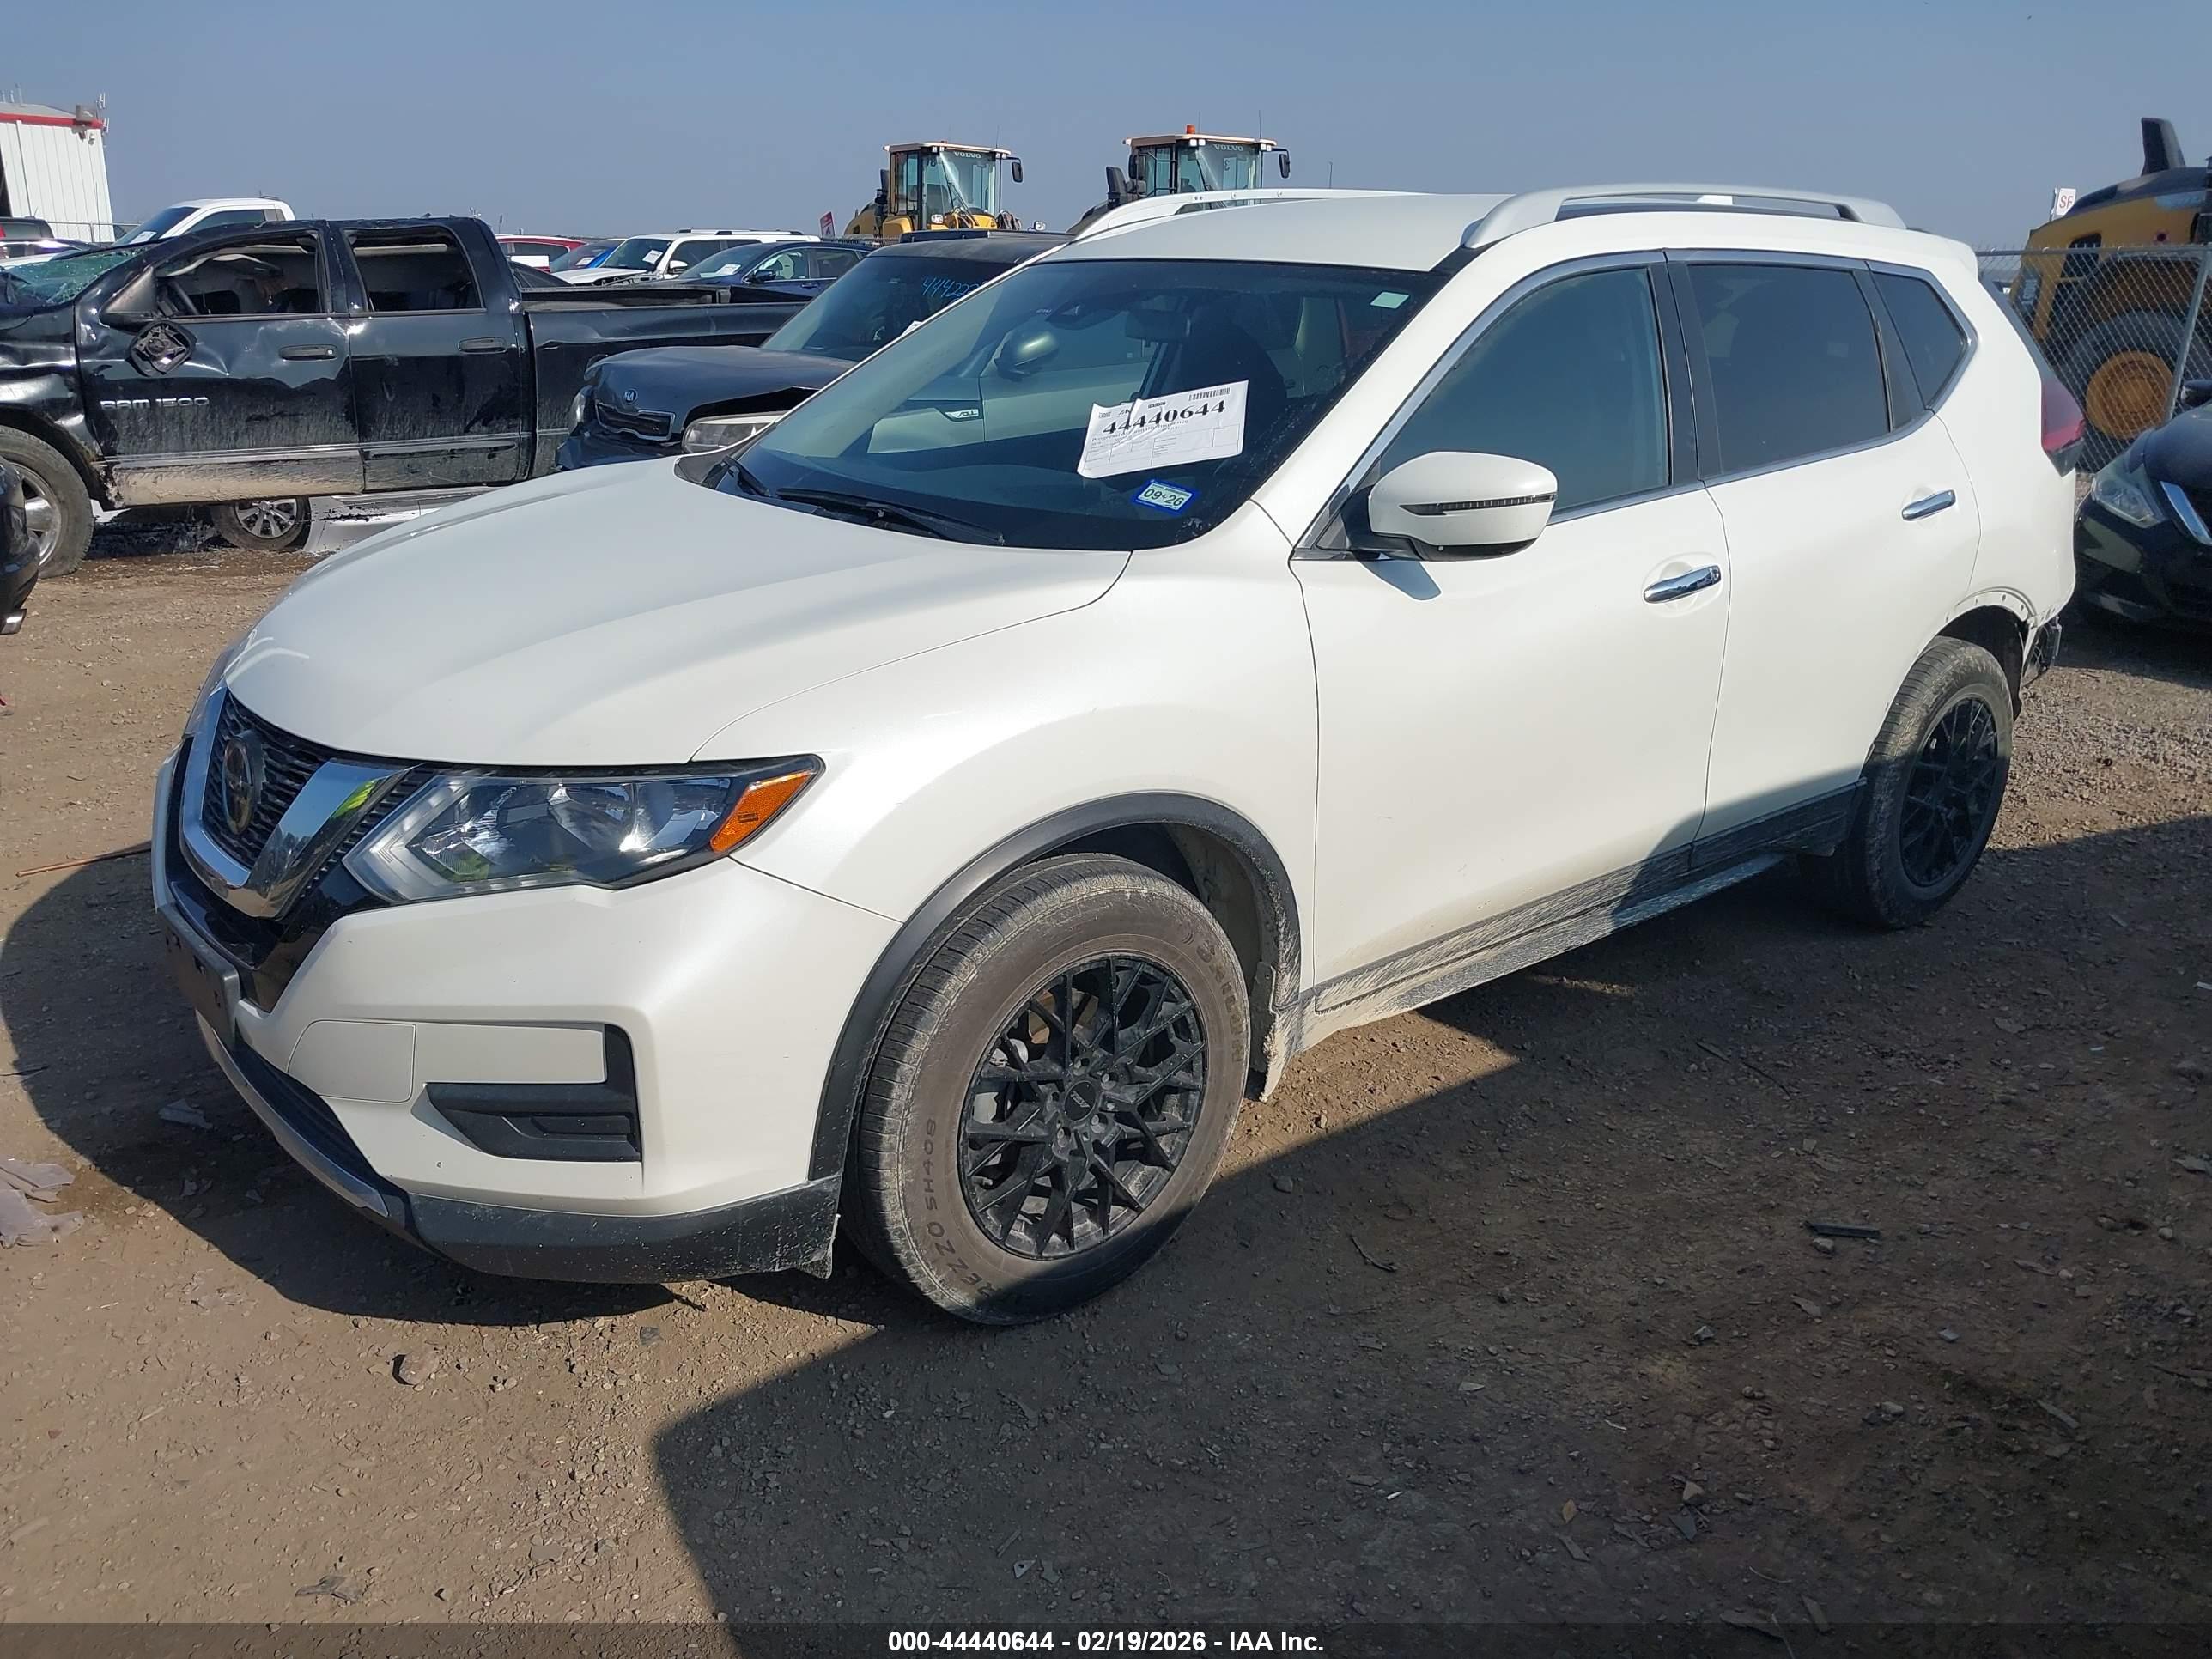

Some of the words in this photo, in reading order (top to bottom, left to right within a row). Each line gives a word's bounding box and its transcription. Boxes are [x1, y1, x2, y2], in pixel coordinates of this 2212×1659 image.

[954, 150, 981, 159] VOLVO
[1213, 143, 1244, 152] VOLVO
[155, 397, 209, 408] 1500
[1103, 399, 1225, 434] 44440644
[1143, 489, 1163, 500] 09
[1164, 495, 1184, 507] 26
[922, 1118, 938, 1211] SH408
